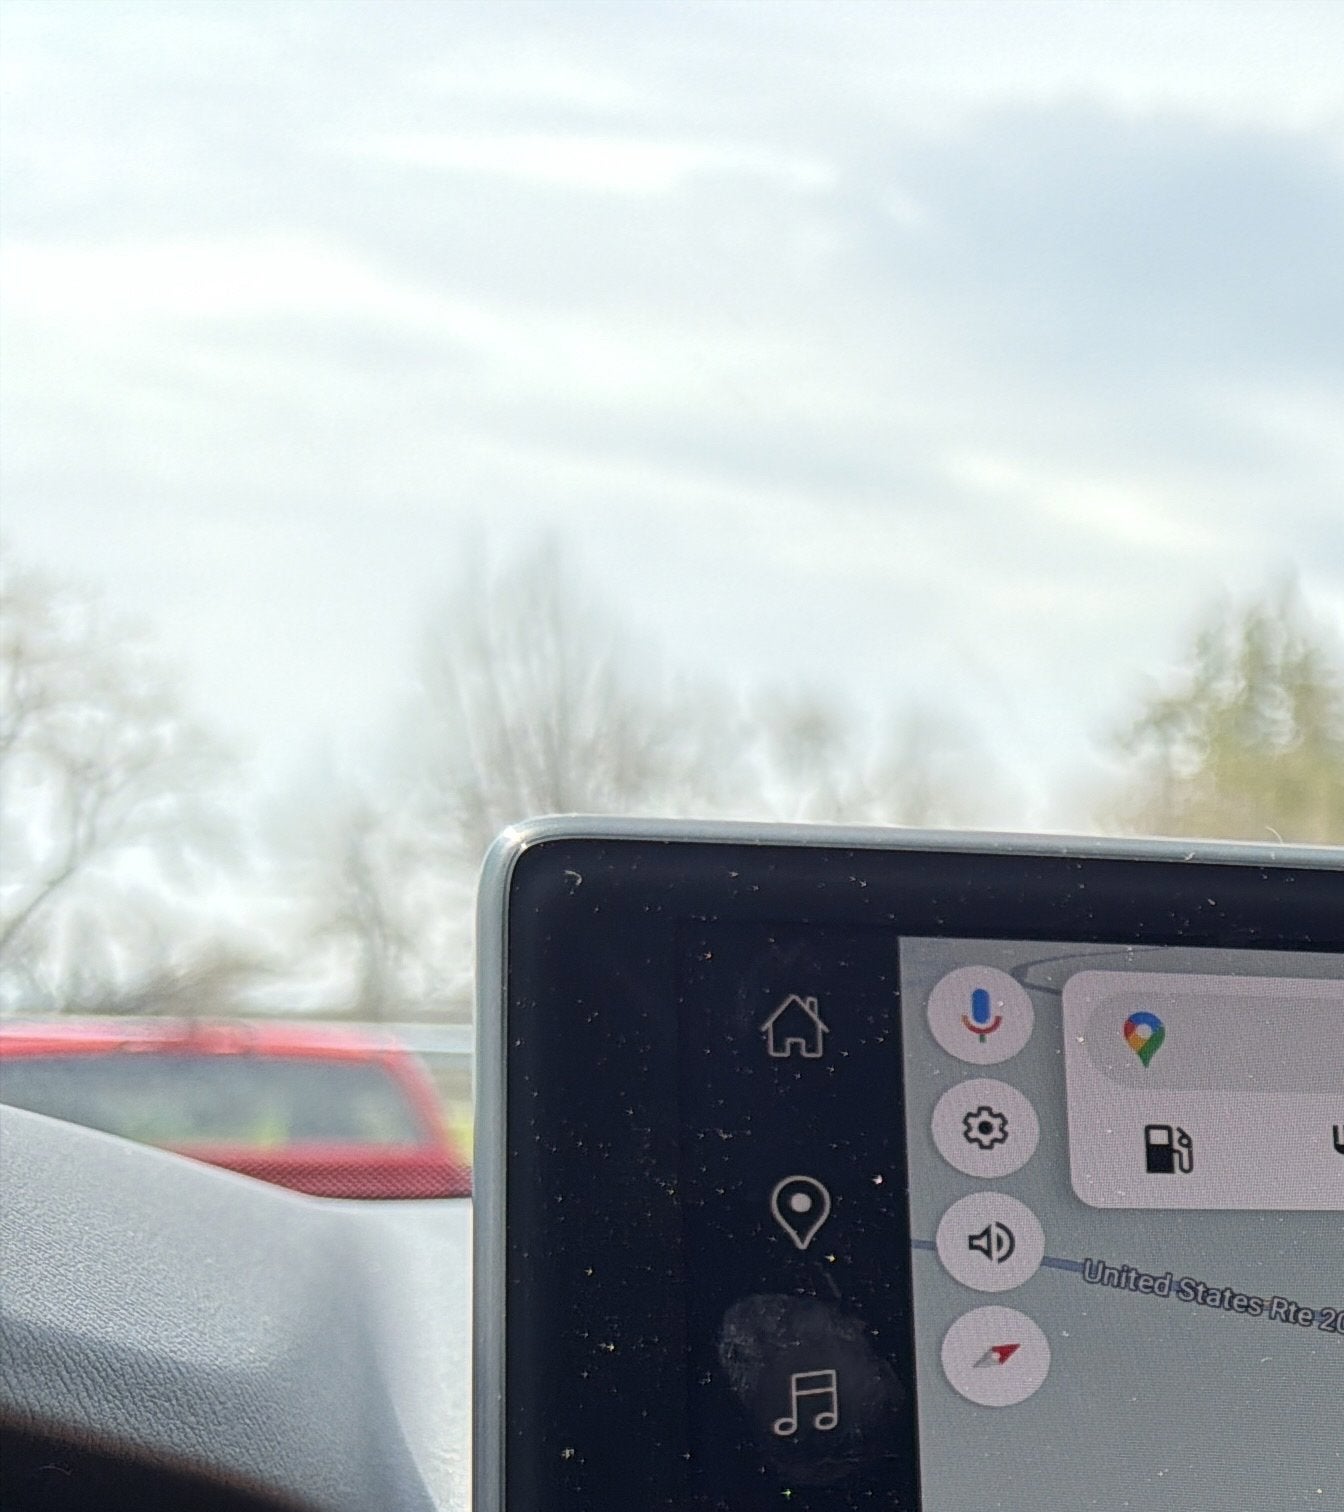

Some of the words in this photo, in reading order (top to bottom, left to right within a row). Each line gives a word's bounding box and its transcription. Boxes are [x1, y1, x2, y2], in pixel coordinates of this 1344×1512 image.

[1083, 1259, 1174, 1298] United
[1177, 1279, 1264, 1318] States
[1269, 1296, 1314, 1328] Rte
